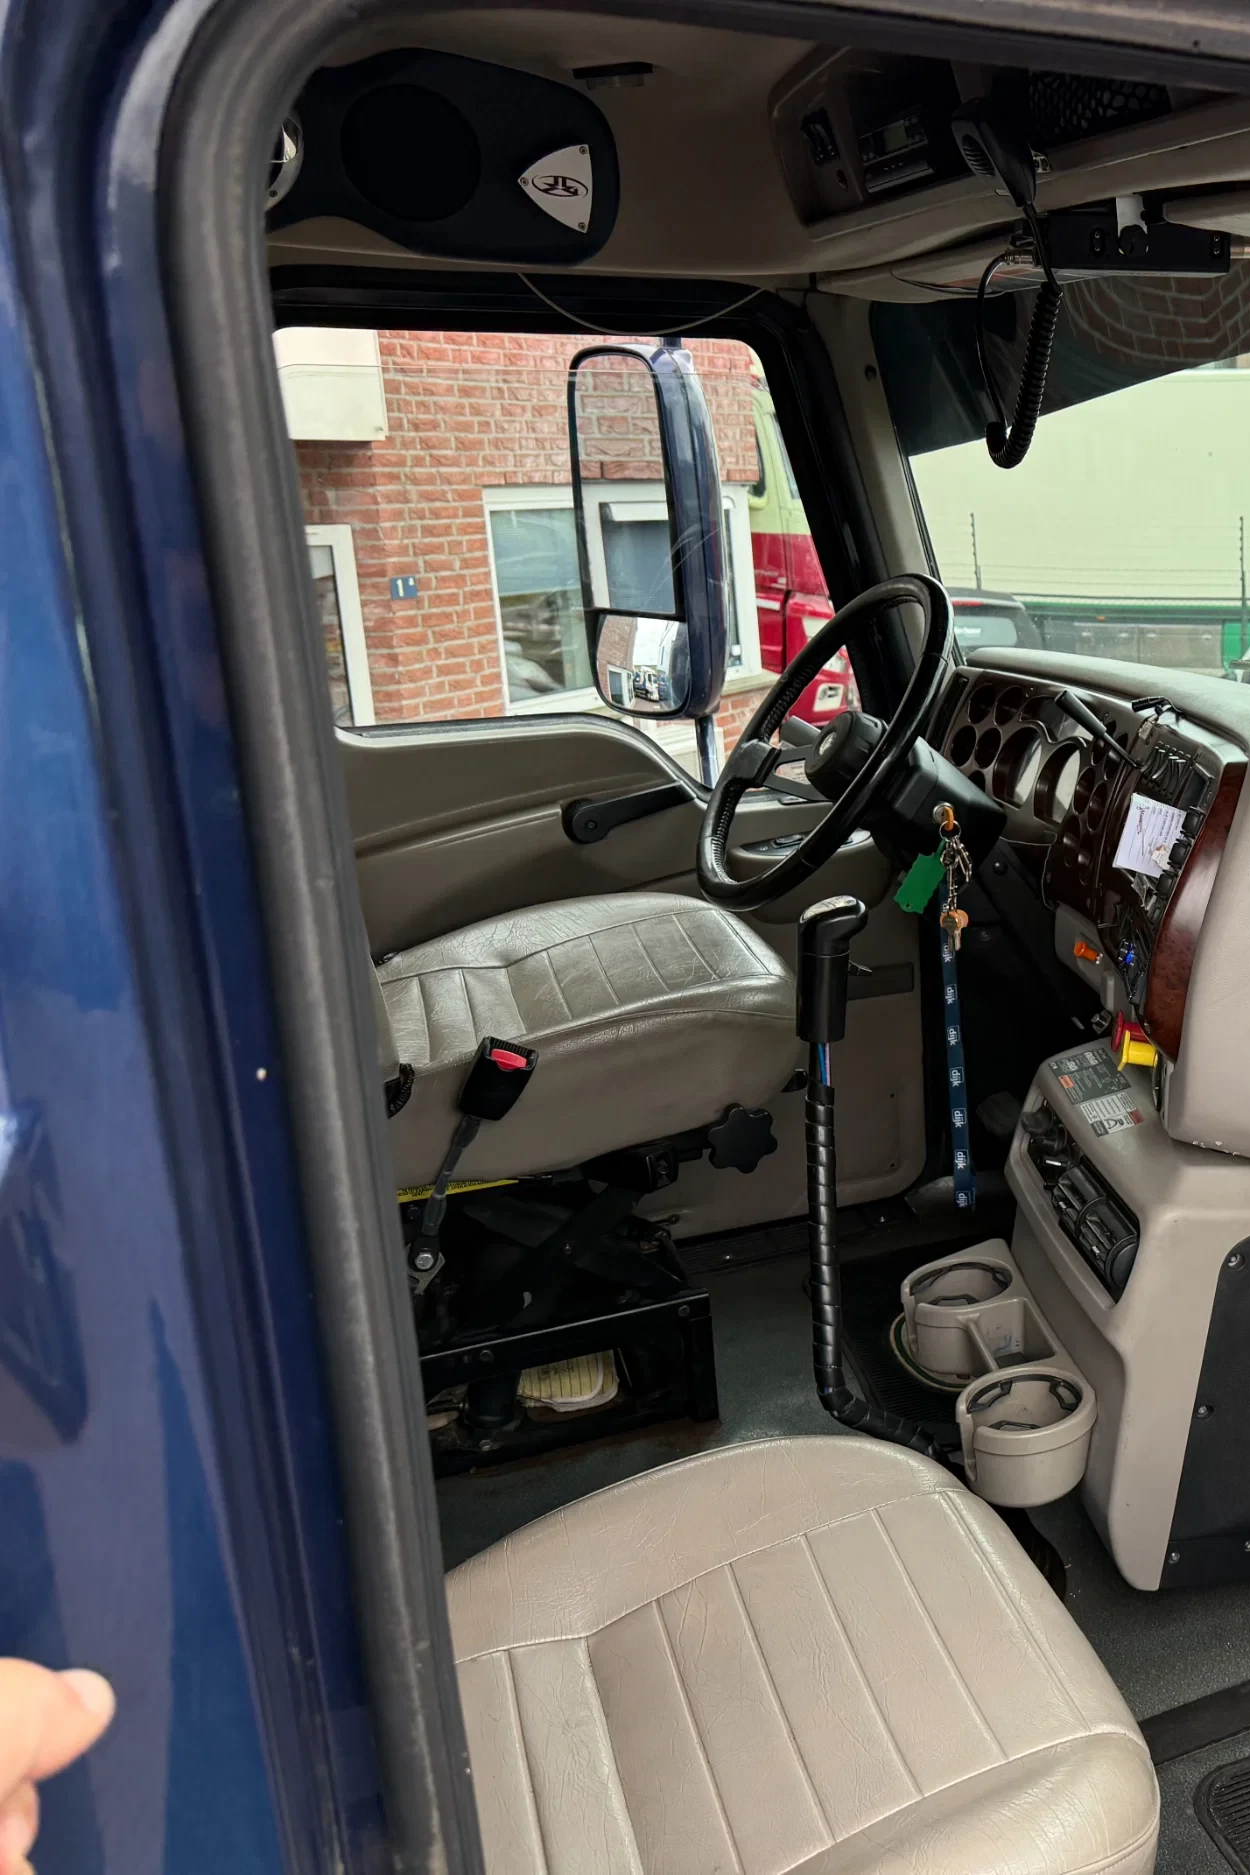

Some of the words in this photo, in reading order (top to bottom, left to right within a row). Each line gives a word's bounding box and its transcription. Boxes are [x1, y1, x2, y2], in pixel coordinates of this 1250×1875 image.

[945, 986, 954, 1004] dijk
[947, 1028, 957, 1046] dijk
[950, 1069, 960, 1087] dijk
[952, 1110, 963, 1128] dijk
[955, 1151, 966, 1169] dijk
